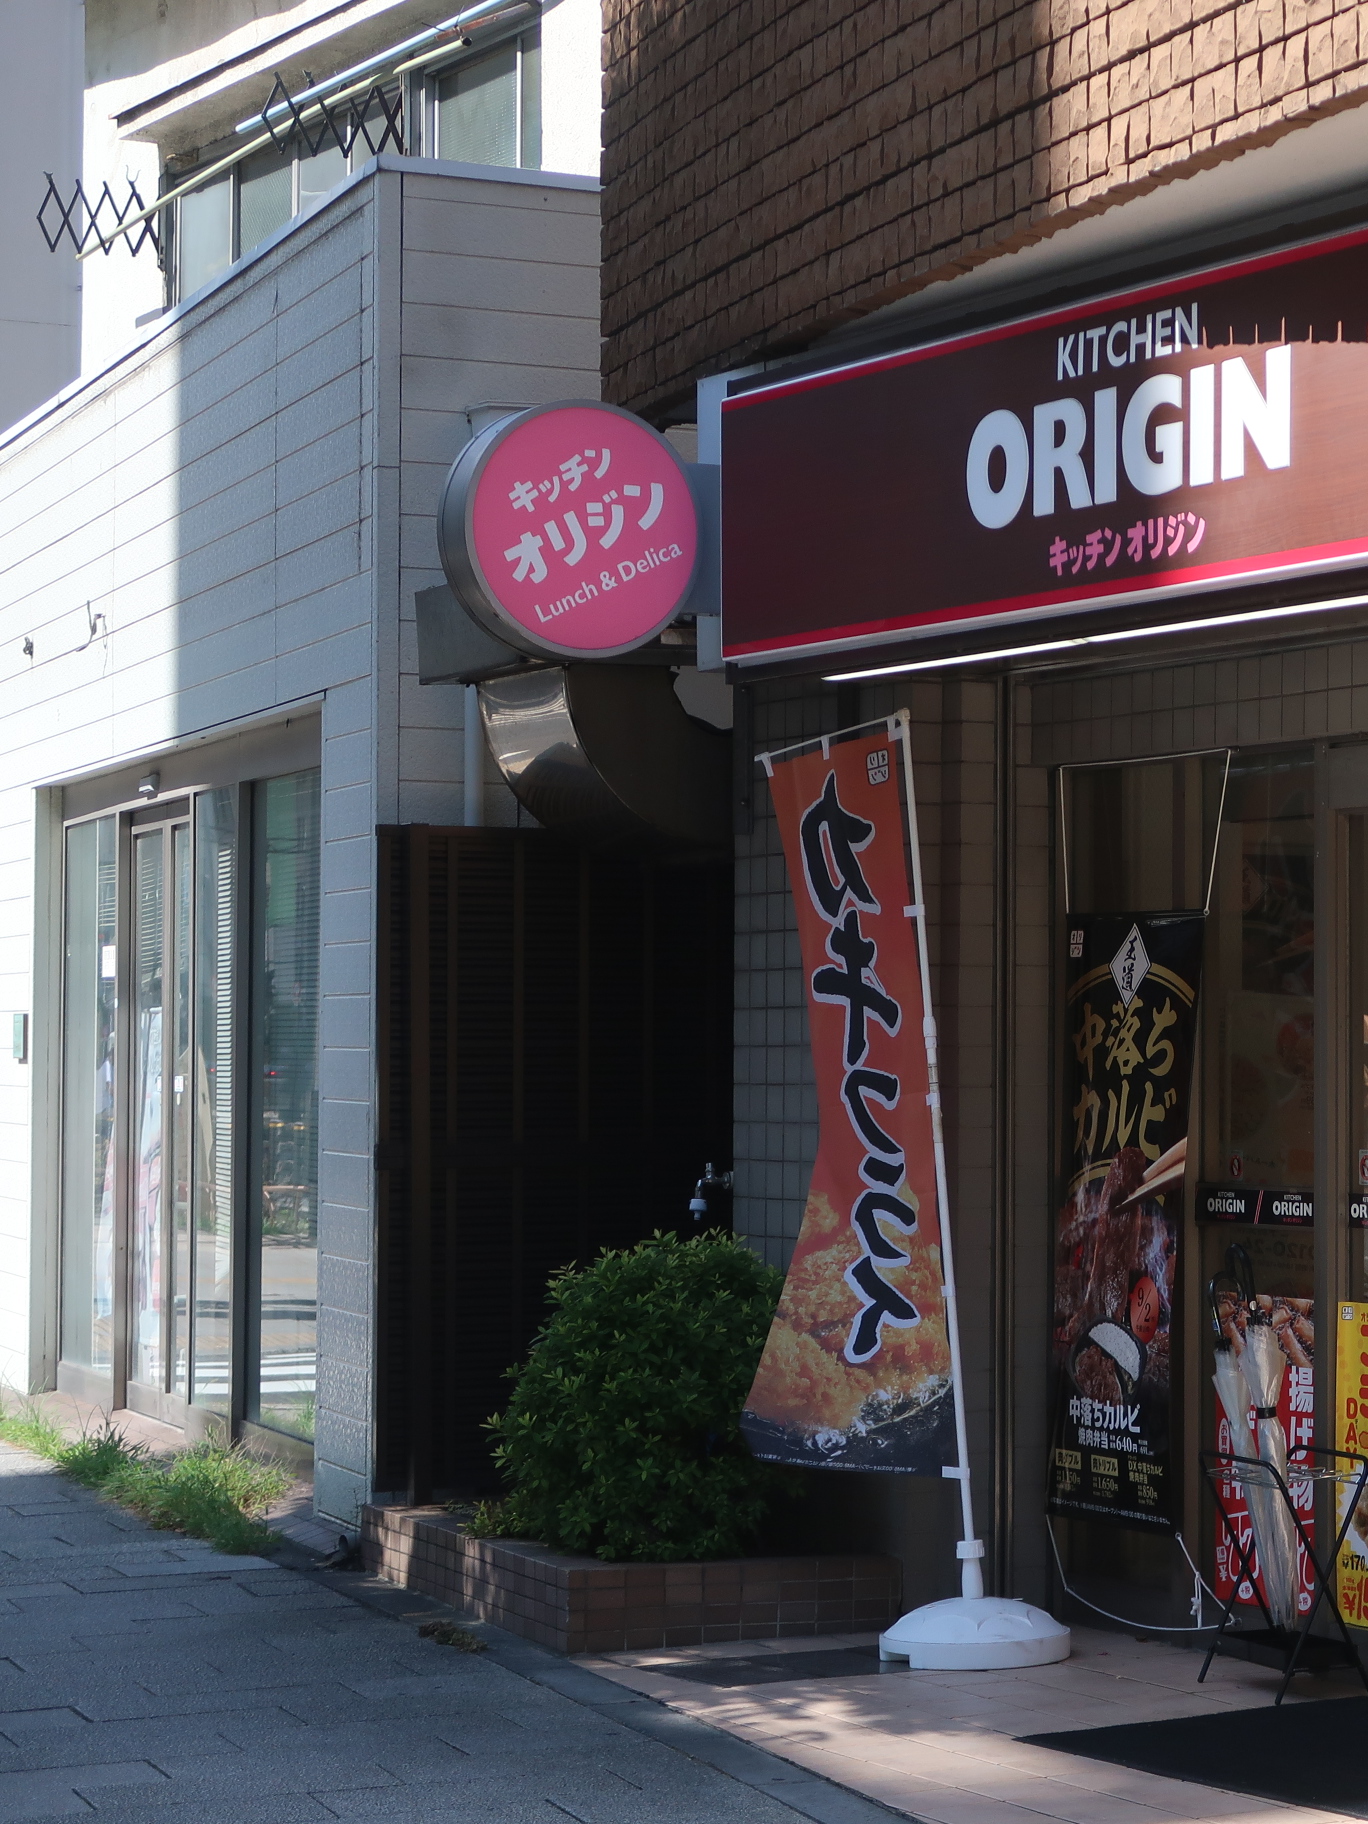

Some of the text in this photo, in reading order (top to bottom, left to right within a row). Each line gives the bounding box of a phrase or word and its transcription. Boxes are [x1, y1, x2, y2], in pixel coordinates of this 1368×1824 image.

[1056, 302, 1199, 381] KITCHEN
[966, 344, 1291, 529] ORIGIN
[508, 447, 611, 513] キッチン
[504, 482, 664, 584] オリジン
[534, 538, 683, 623] Lunch & Delica
[1073, 995, 1178, 1082] 中落ち
[1073, 1079, 1177, 1161] カルビ
[1207, 1197, 1245, 1214] ORIGIN
[1272, 1201, 1313, 1217] ORIGIN
[1069, 1395, 1141, 1434] 中落ちカルビ
